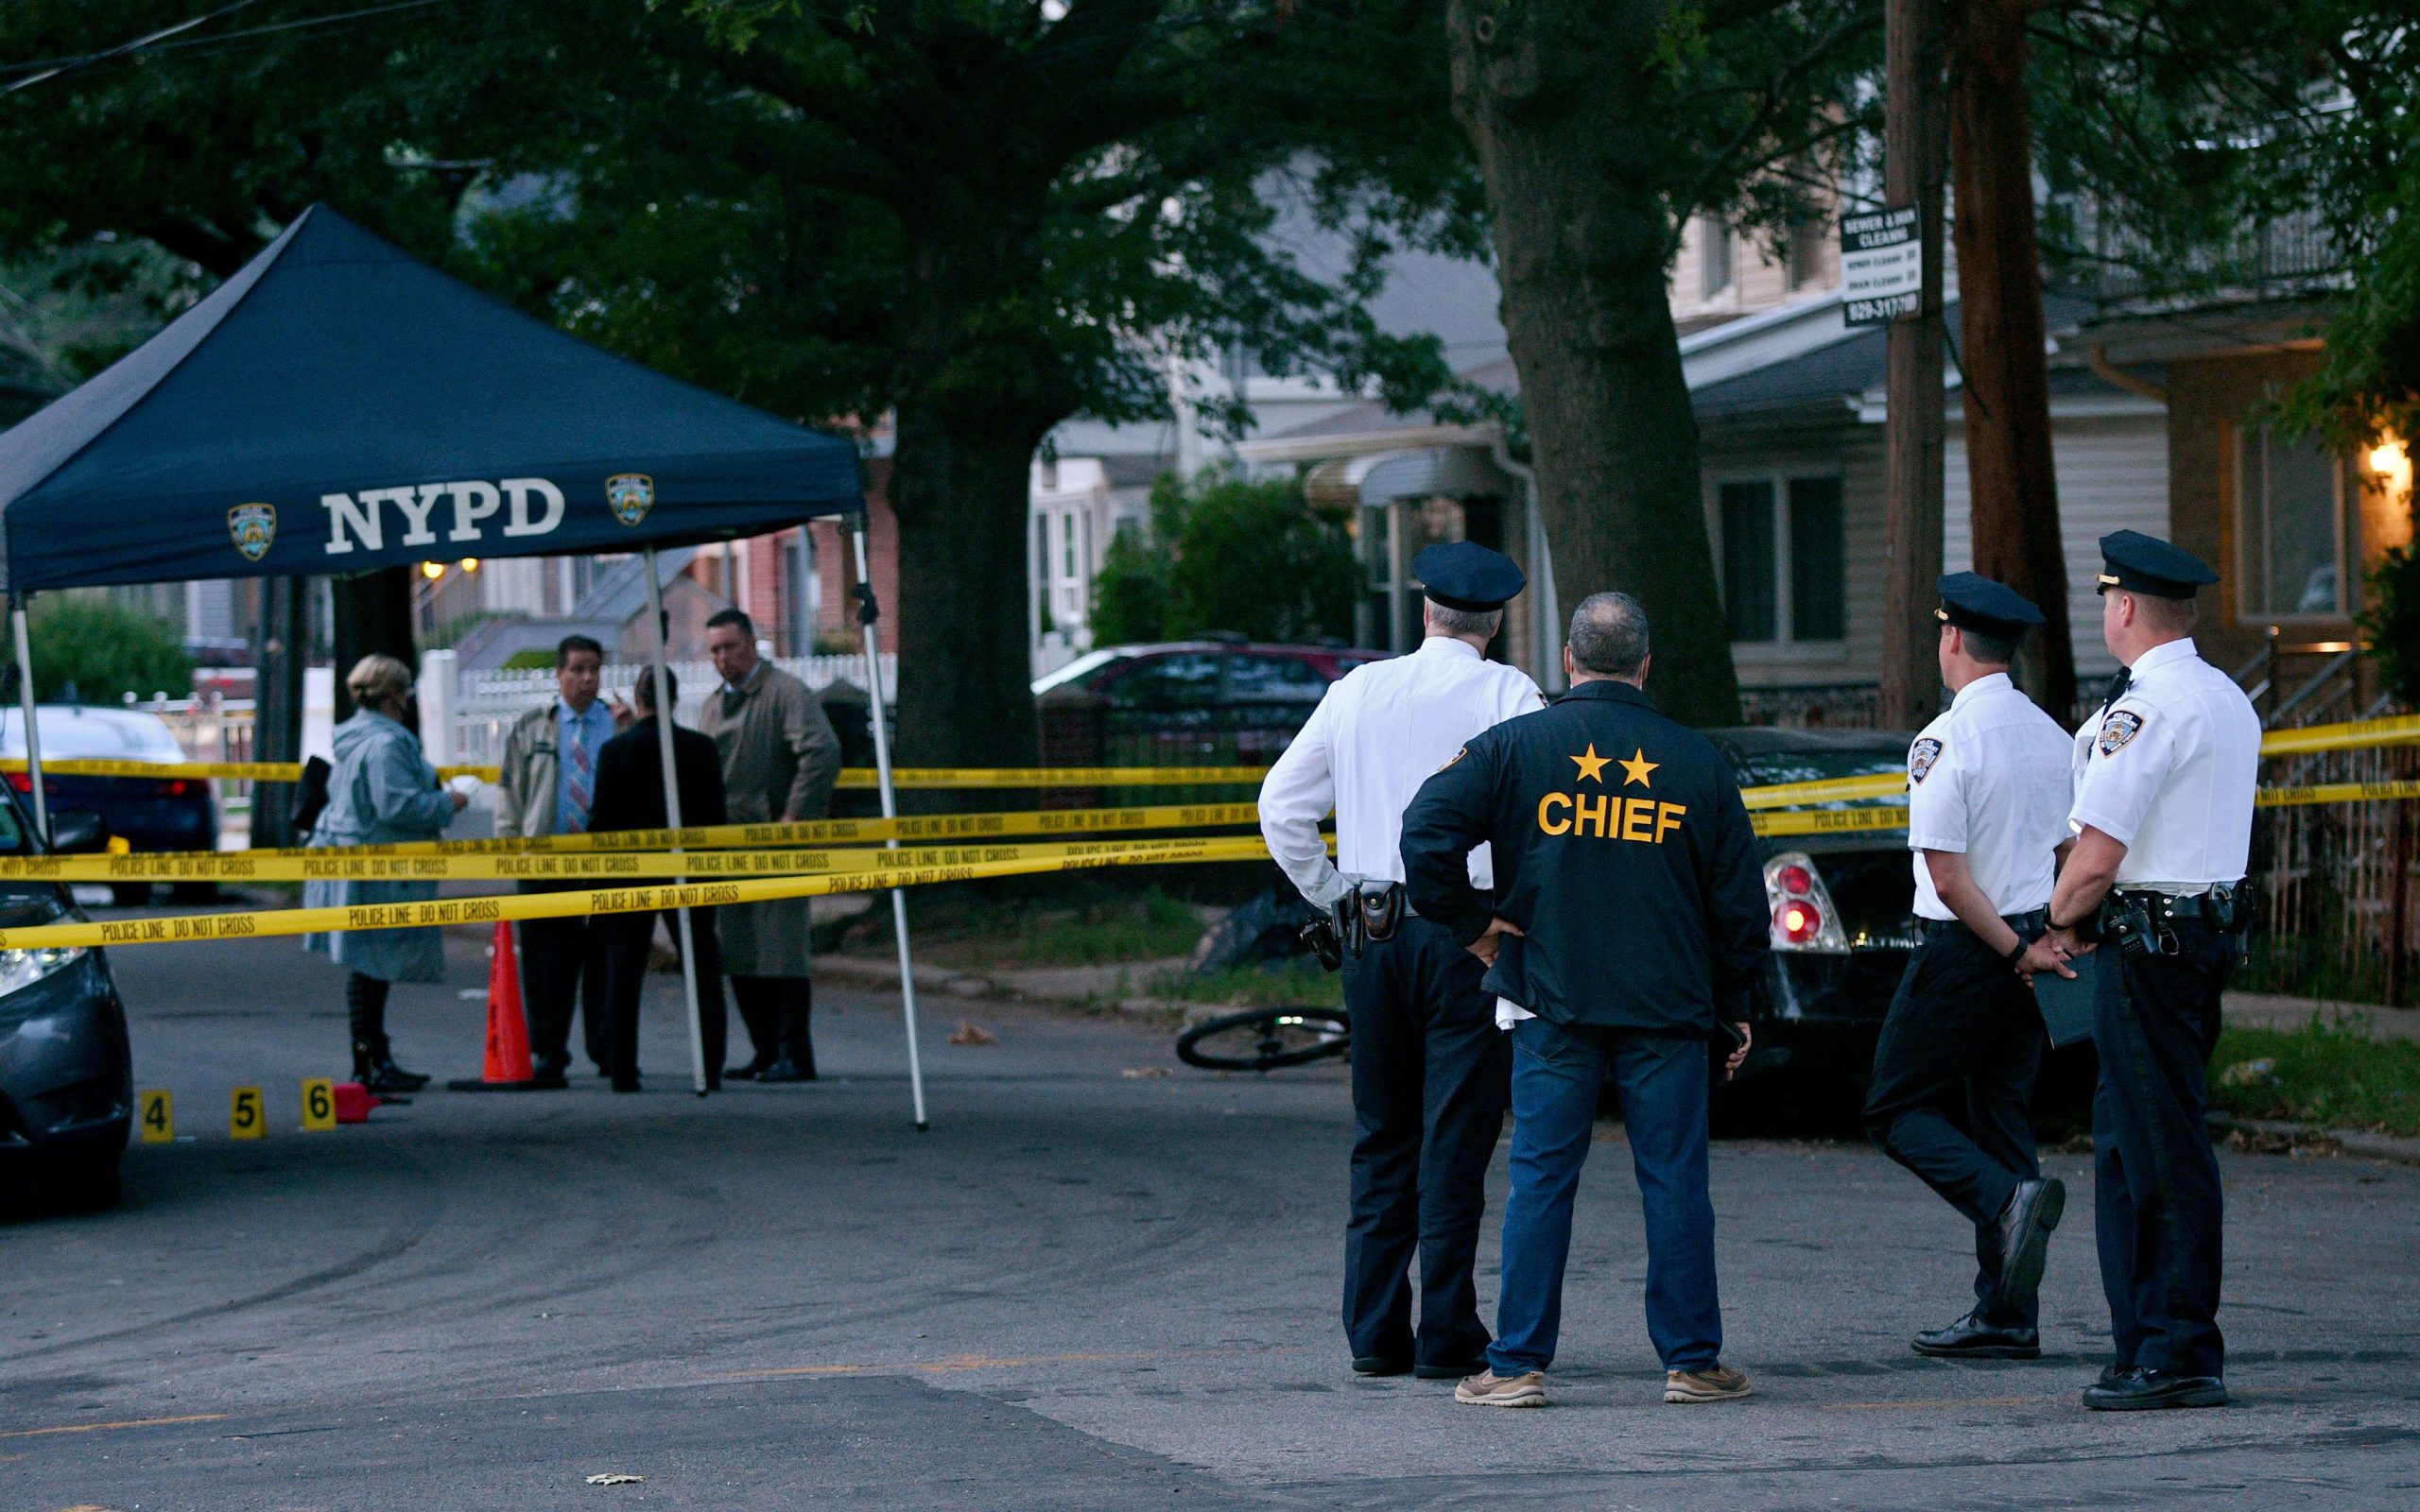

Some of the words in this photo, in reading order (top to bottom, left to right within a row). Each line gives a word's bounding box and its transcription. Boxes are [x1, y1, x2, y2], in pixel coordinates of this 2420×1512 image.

[320, 477, 565, 555] NYPD
[1538, 792, 1686, 844] CHIEF
[1814, 814, 1848, 829] POLICE
[1853, 812, 1873, 827] LINE
[1879, 811, 1893, 825] DO
[26, 859, 61, 875] CROSS
[110, 860, 144, 875] POLICE
[150, 859, 174, 875] LINE
[179, 859, 193, 875] DO
[197, 859, 216, 875] NOT
[221, 859, 255, 875] CROSS
[303, 859, 338, 876] POLICE
[344, 859, 366, 875] LINE
[372, 859, 387, 875] DO
[390, 858, 408, 875] NOT
[414, 858, 449, 874] CROSS
[497, 857, 531, 874] POLICE
[537, 857, 557, 874] LINE
[564, 857, 578, 873] DO
[582, 856, 601, 873] NOT
[605, 856, 639, 872] CROSS
[687, 855, 722, 872] POLICE
[727, 854, 750, 871] LINE
[754, 854, 769, 870] DO
[771, 854, 791, 870] NOT
[796, 852, 830, 869] CROSS
[878, 851, 912, 868] POLICE
[917, 850, 939, 867] LINE
[944, 850, 959, 866] DO
[962, 849, 981, 864] NOT
[986, 847, 1019, 862] CROSS
[829, 876, 864, 893] POLICE
[867, 873, 890, 890] LINE
[898, 871, 912, 886] DO
[915, 869, 935, 885] NOT
[592, 893, 628, 912] POLICE
[630, 890, 652, 909] LINE
[662, 889, 675, 906] DO
[679, 887, 700, 905] NOT
[703, 885, 739, 903] CROSS
[350, 906, 386, 927] POLICE
[389, 905, 412, 925] LINE
[421, 904, 435, 923] DO
[439, 902, 459, 922] NOT
[464, 901, 500, 920] CROSS
[101, 922, 140, 941] POLICE
[143, 921, 165, 939] LINE
[175, 919, 189, 937] DO
[193, 918, 214, 936] NOT
[219, 916, 255, 936] CROSS
[145, 1096, 166, 1132] 4
[236, 1093, 256, 1128] 5
[309, 1085, 330, 1120] 6
